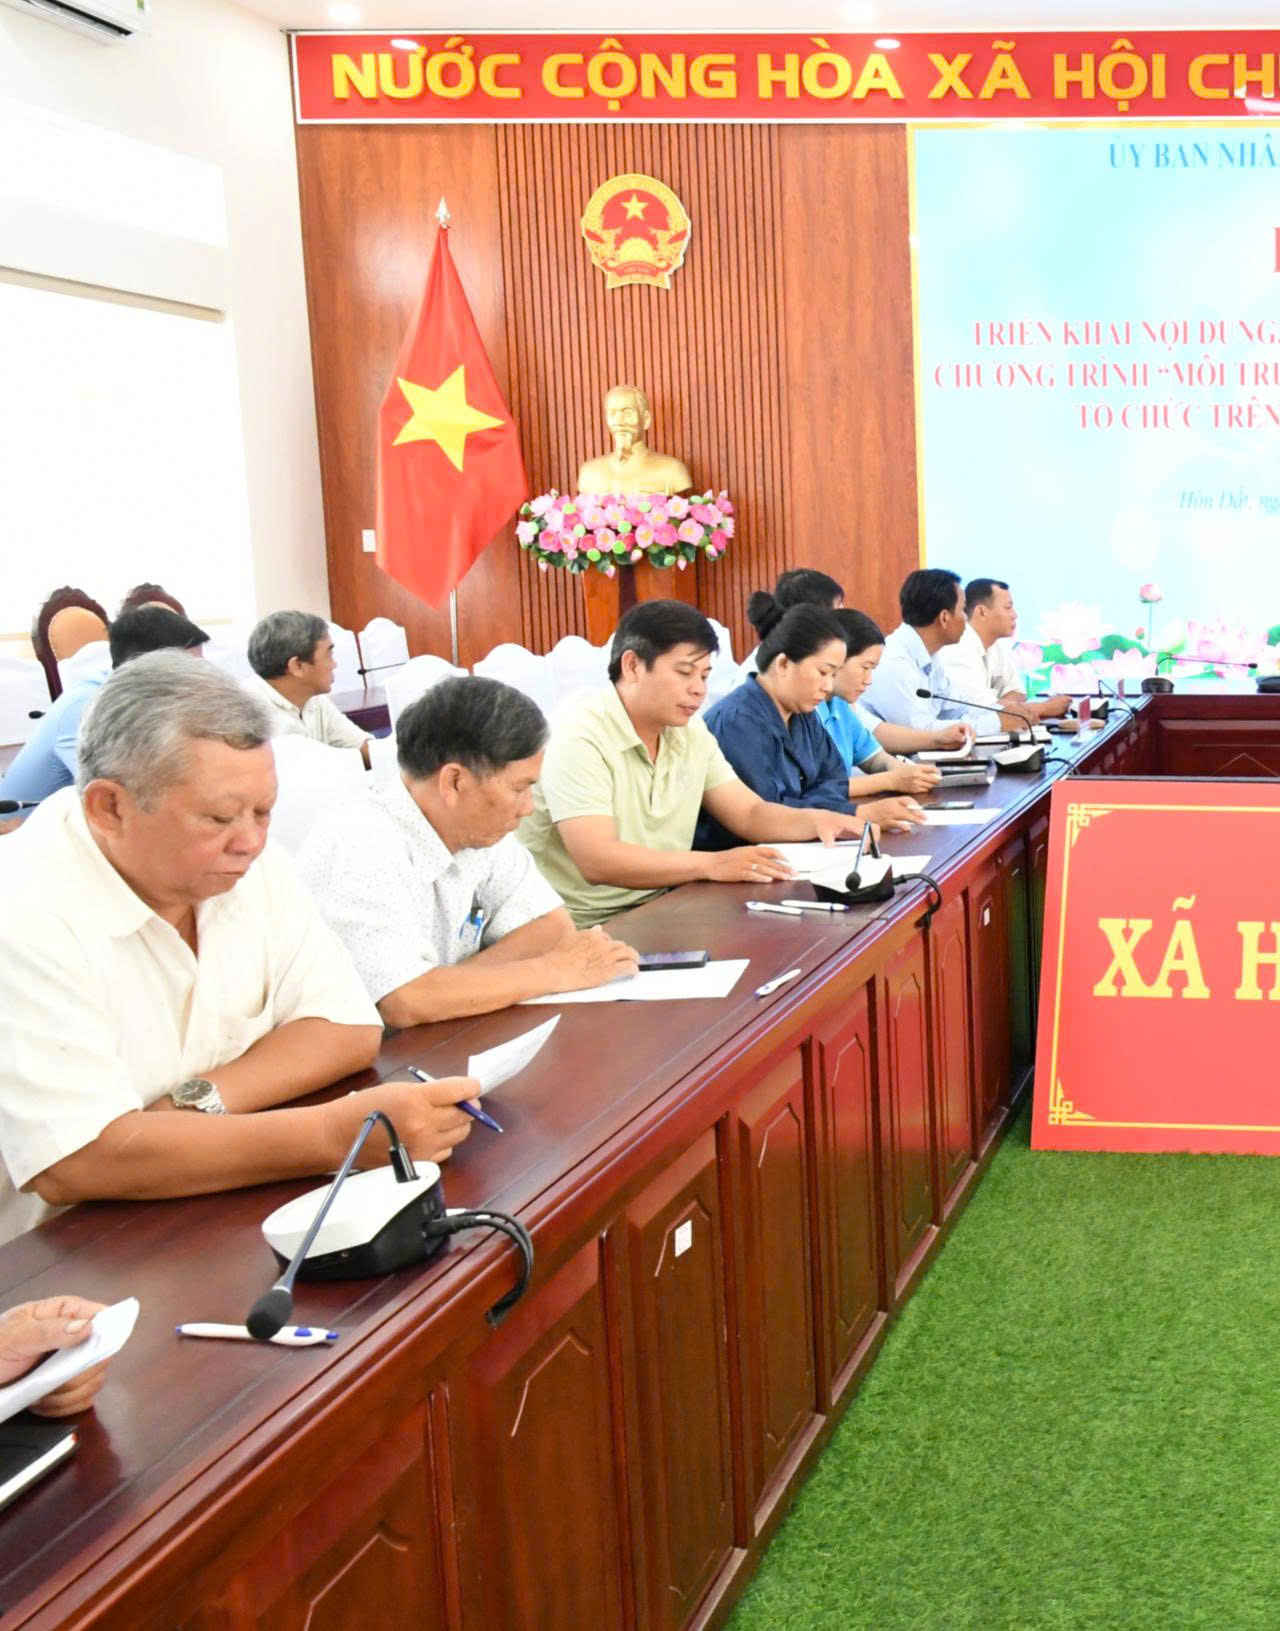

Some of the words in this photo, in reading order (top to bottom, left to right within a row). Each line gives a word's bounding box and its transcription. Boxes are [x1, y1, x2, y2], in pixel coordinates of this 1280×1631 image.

[332, 37, 521, 98] NƯỚC
[541, 37, 737, 111] CỘNG
[757, 37, 905, 99] HÒA
[927, 40, 1032, 99] XÃ
[1053, 38, 1166, 112] HỘI
[1154, 142, 1209, 168] BAN
[1063, 320, 1131, 345] KHAI
[1211, 395, 1280, 429] TRÊN
[1093, 894, 1211, 999] XÃ
